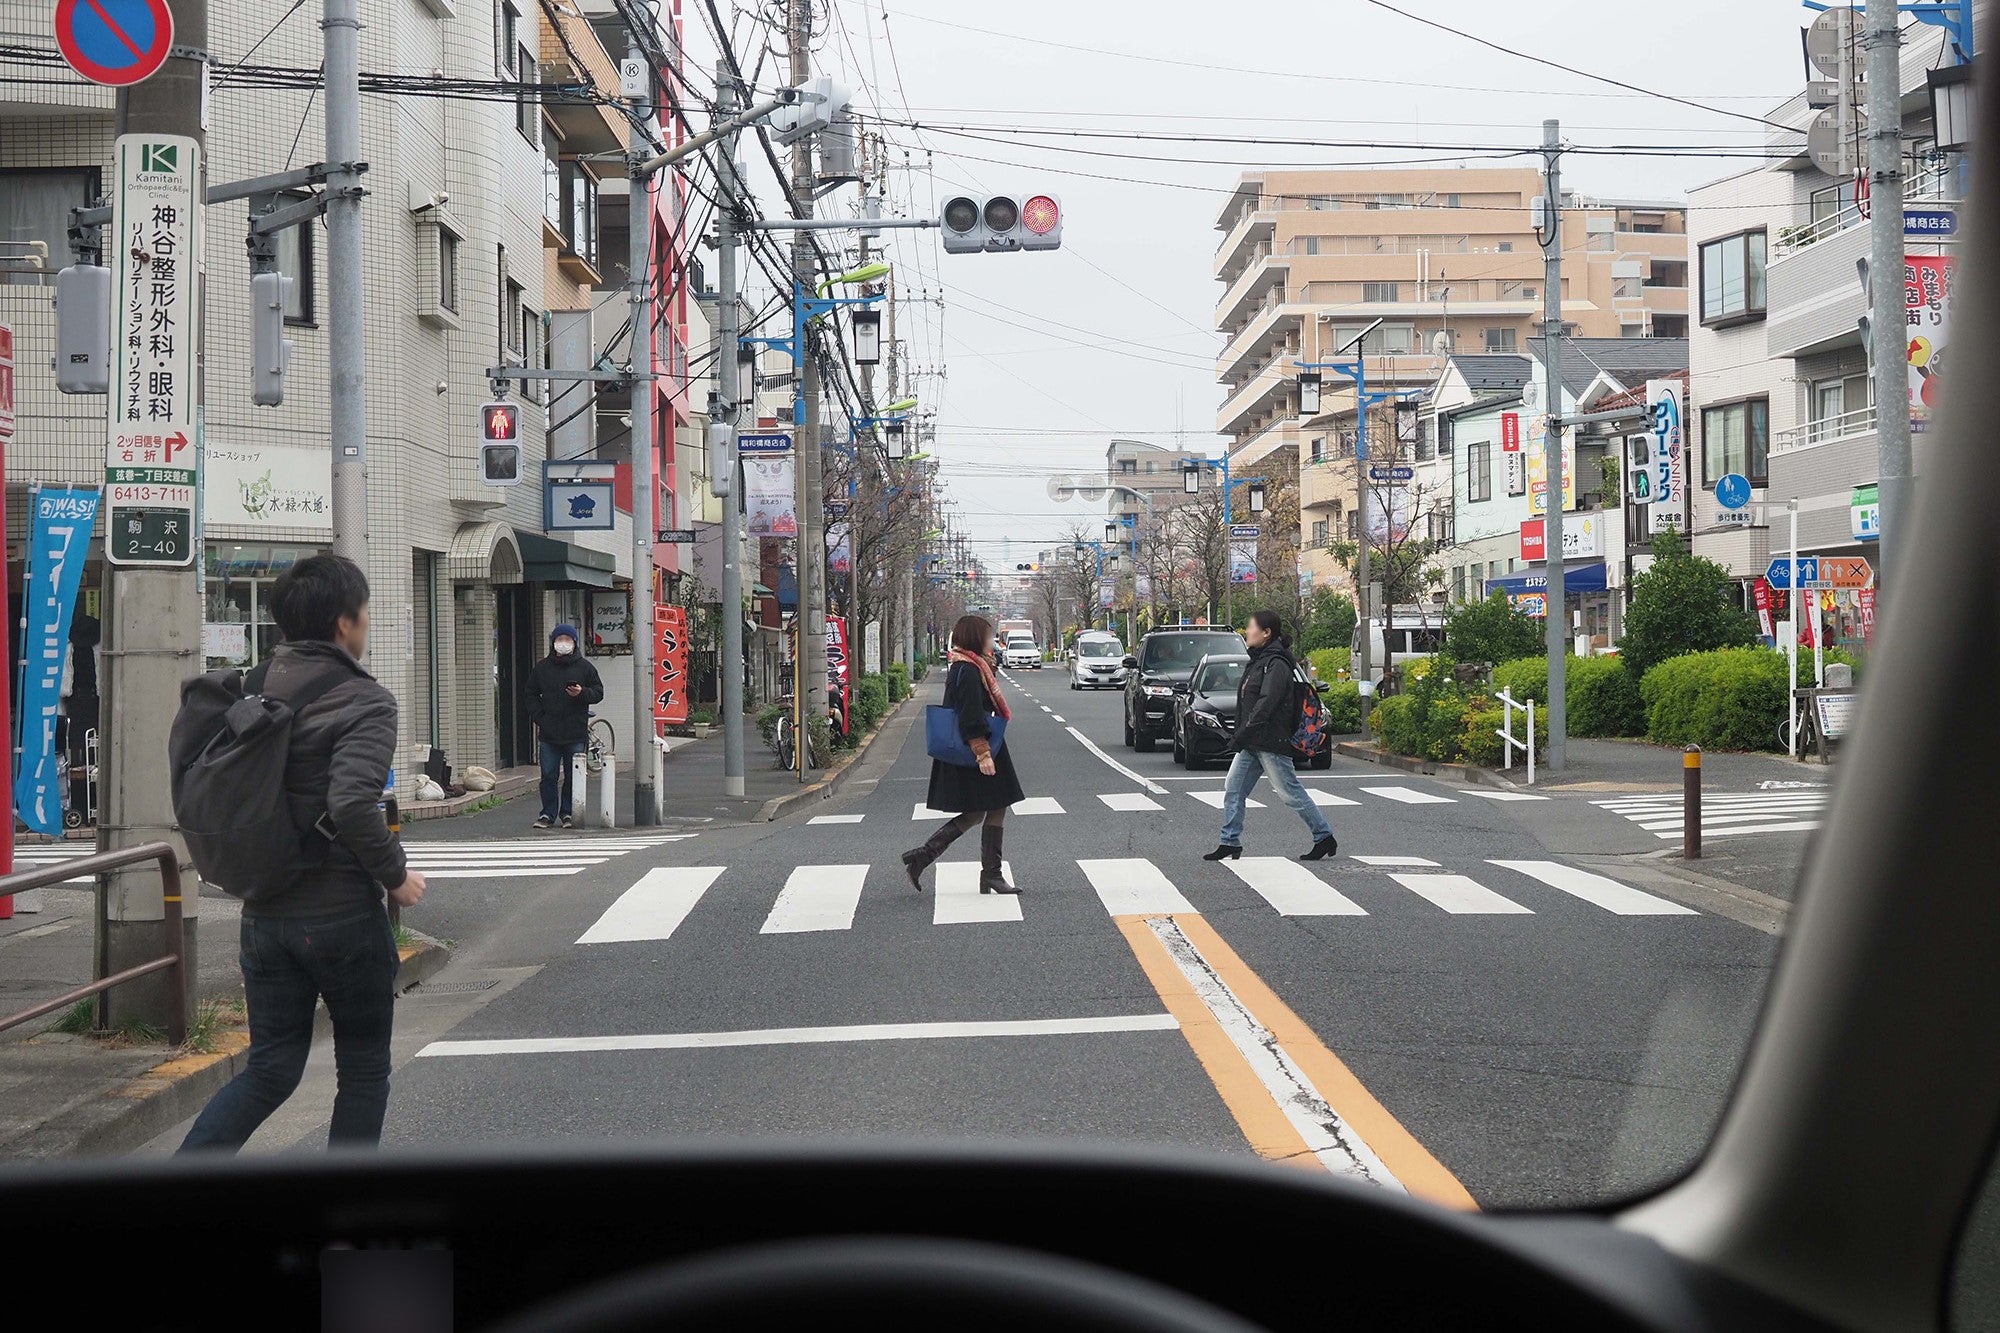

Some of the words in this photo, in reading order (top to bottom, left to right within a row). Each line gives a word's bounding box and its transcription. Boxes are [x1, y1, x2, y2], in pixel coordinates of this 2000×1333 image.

[135, 173, 183, 184] Kamitani
[148, 192, 169, 200] Clinic
[1922, 267, 1943, 326] みまもり
[148, 204, 177, 423] 神谷整形外科・眼科
[115, 469, 189, 483] 弦巻一丁目交差点
[114, 486, 190, 502] 6413-7111
[55, 498, 97, 514] WASH
[1717, 510, 1750, 522] 歩行者優先
[1523, 536, 1543, 547] TOSHIBA
